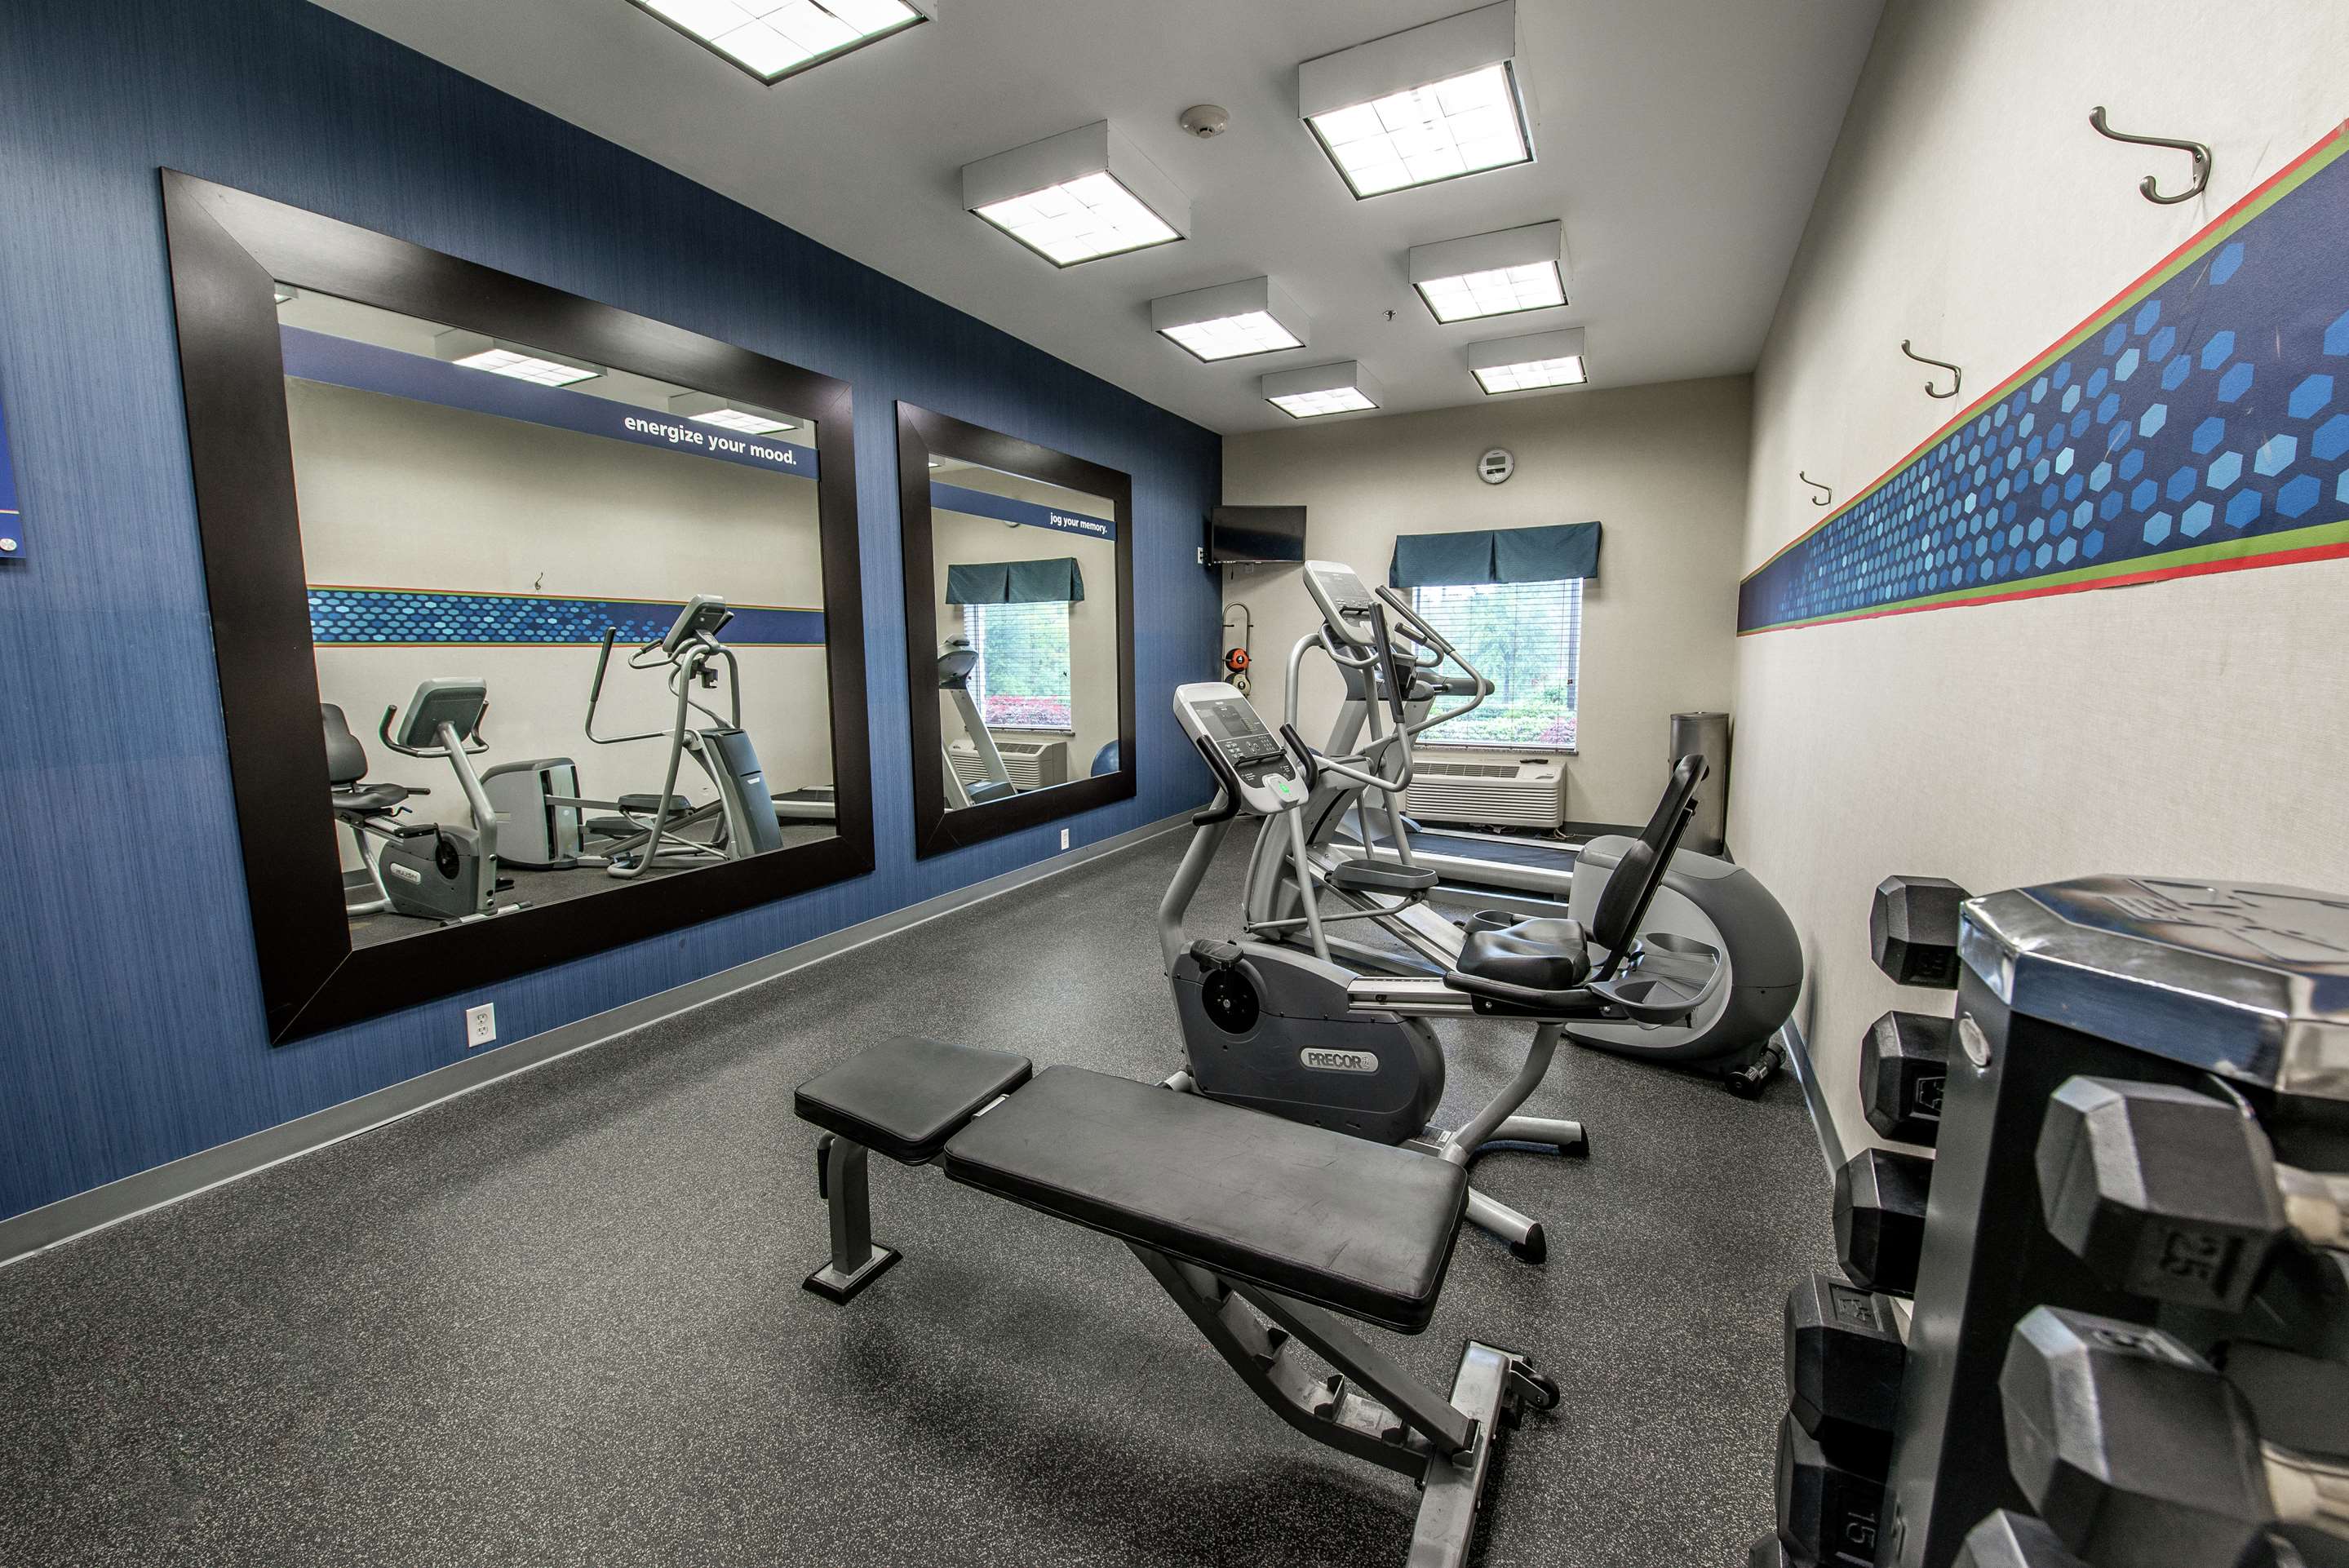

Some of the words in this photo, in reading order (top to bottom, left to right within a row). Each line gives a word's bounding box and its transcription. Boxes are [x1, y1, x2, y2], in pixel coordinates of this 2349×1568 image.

[624, 416, 703, 445] energize
[707, 435, 746, 454] your
[750, 444, 797, 465] mood.
[1050, 512, 1062, 526] jog
[1063, 516, 1079, 527] your
[1080, 520, 1108, 535] memory.
[1307, 1052, 1363, 1070] PRECOR
